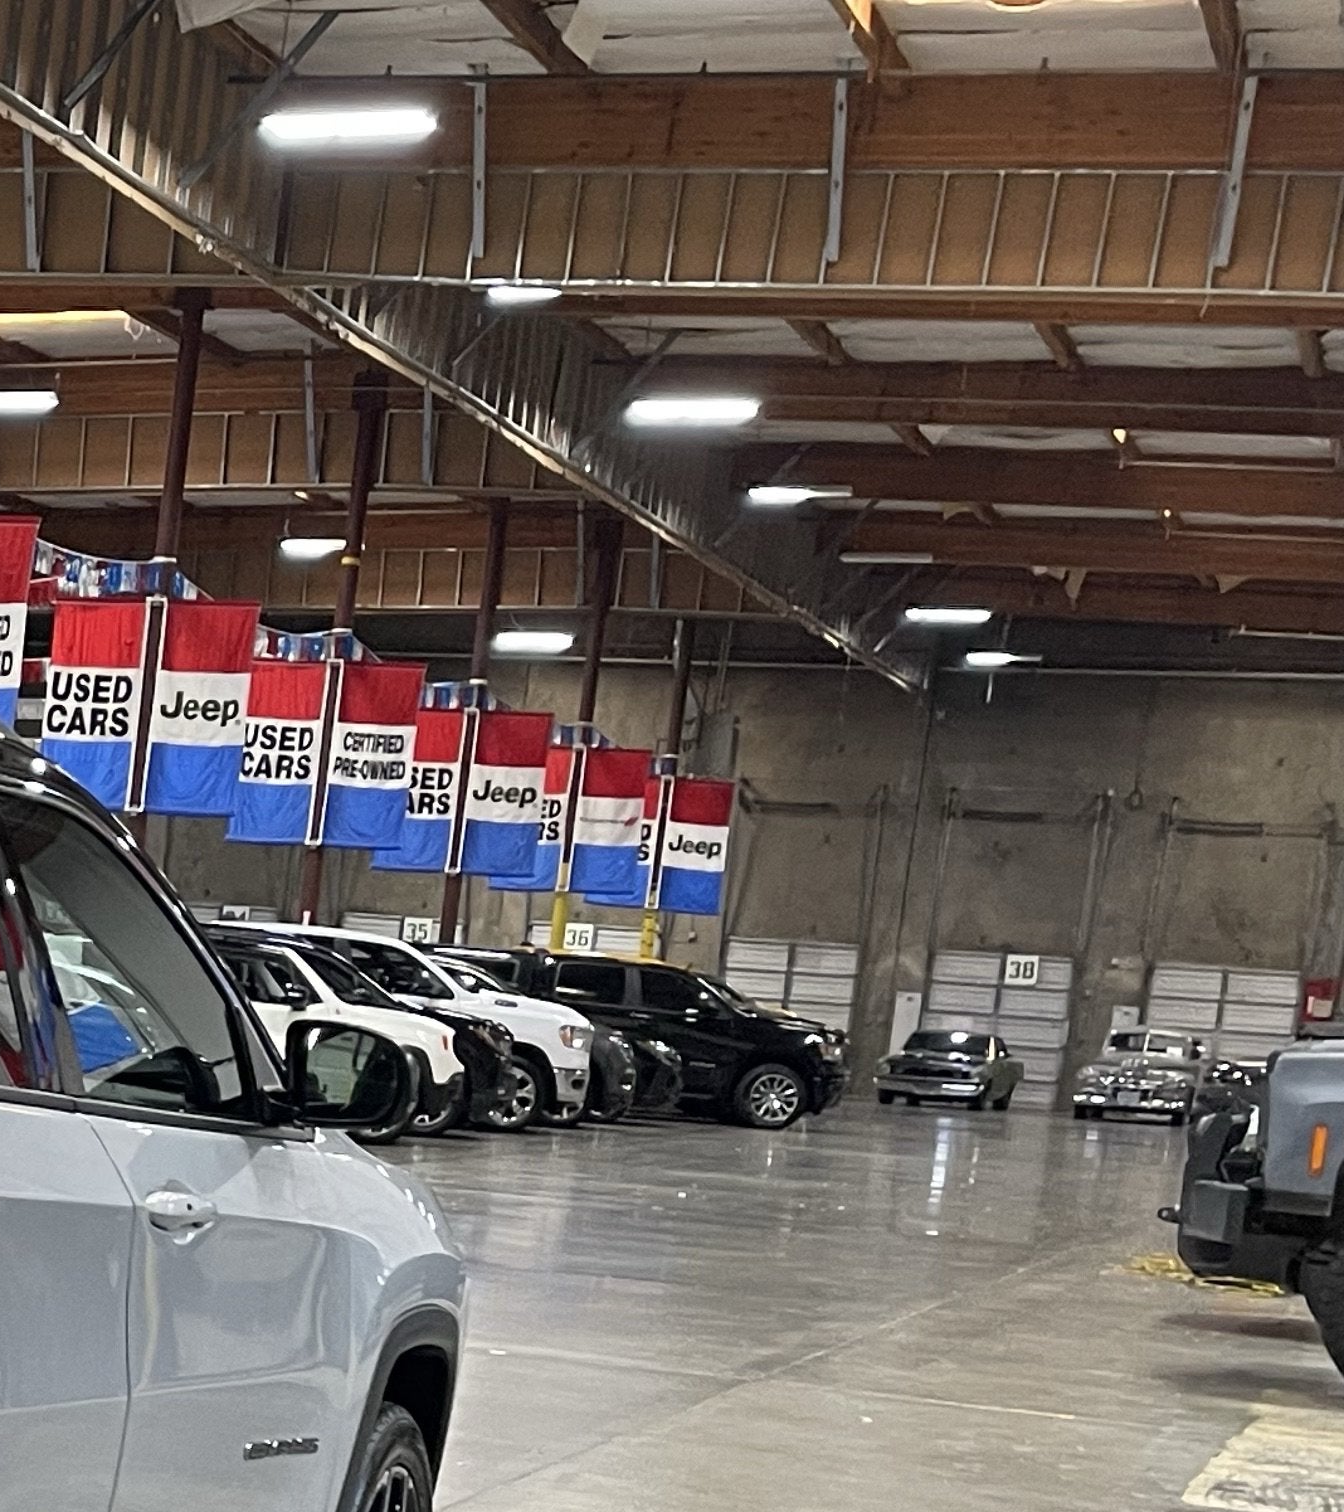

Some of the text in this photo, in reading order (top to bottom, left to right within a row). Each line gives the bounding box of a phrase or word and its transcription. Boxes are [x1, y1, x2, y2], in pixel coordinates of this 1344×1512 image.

[51, 671, 133, 704] USED
[46, 704, 129, 737] CARS
[160, 690, 239, 727] Jeep
[244, 723, 313, 751] USED
[343, 731, 405, 754] CERTIFIED
[240, 751, 311, 779] CARS
[332, 756, 406, 780] PRE-OWNED
[409, 766, 453, 790] SED
[472, 780, 537, 808] Jeep
[668, 834, 722, 860] Jeep
[406, 922, 429, 941] 35
[566, 929, 590, 947] 36
[1008, 960, 1035, 979] 38
